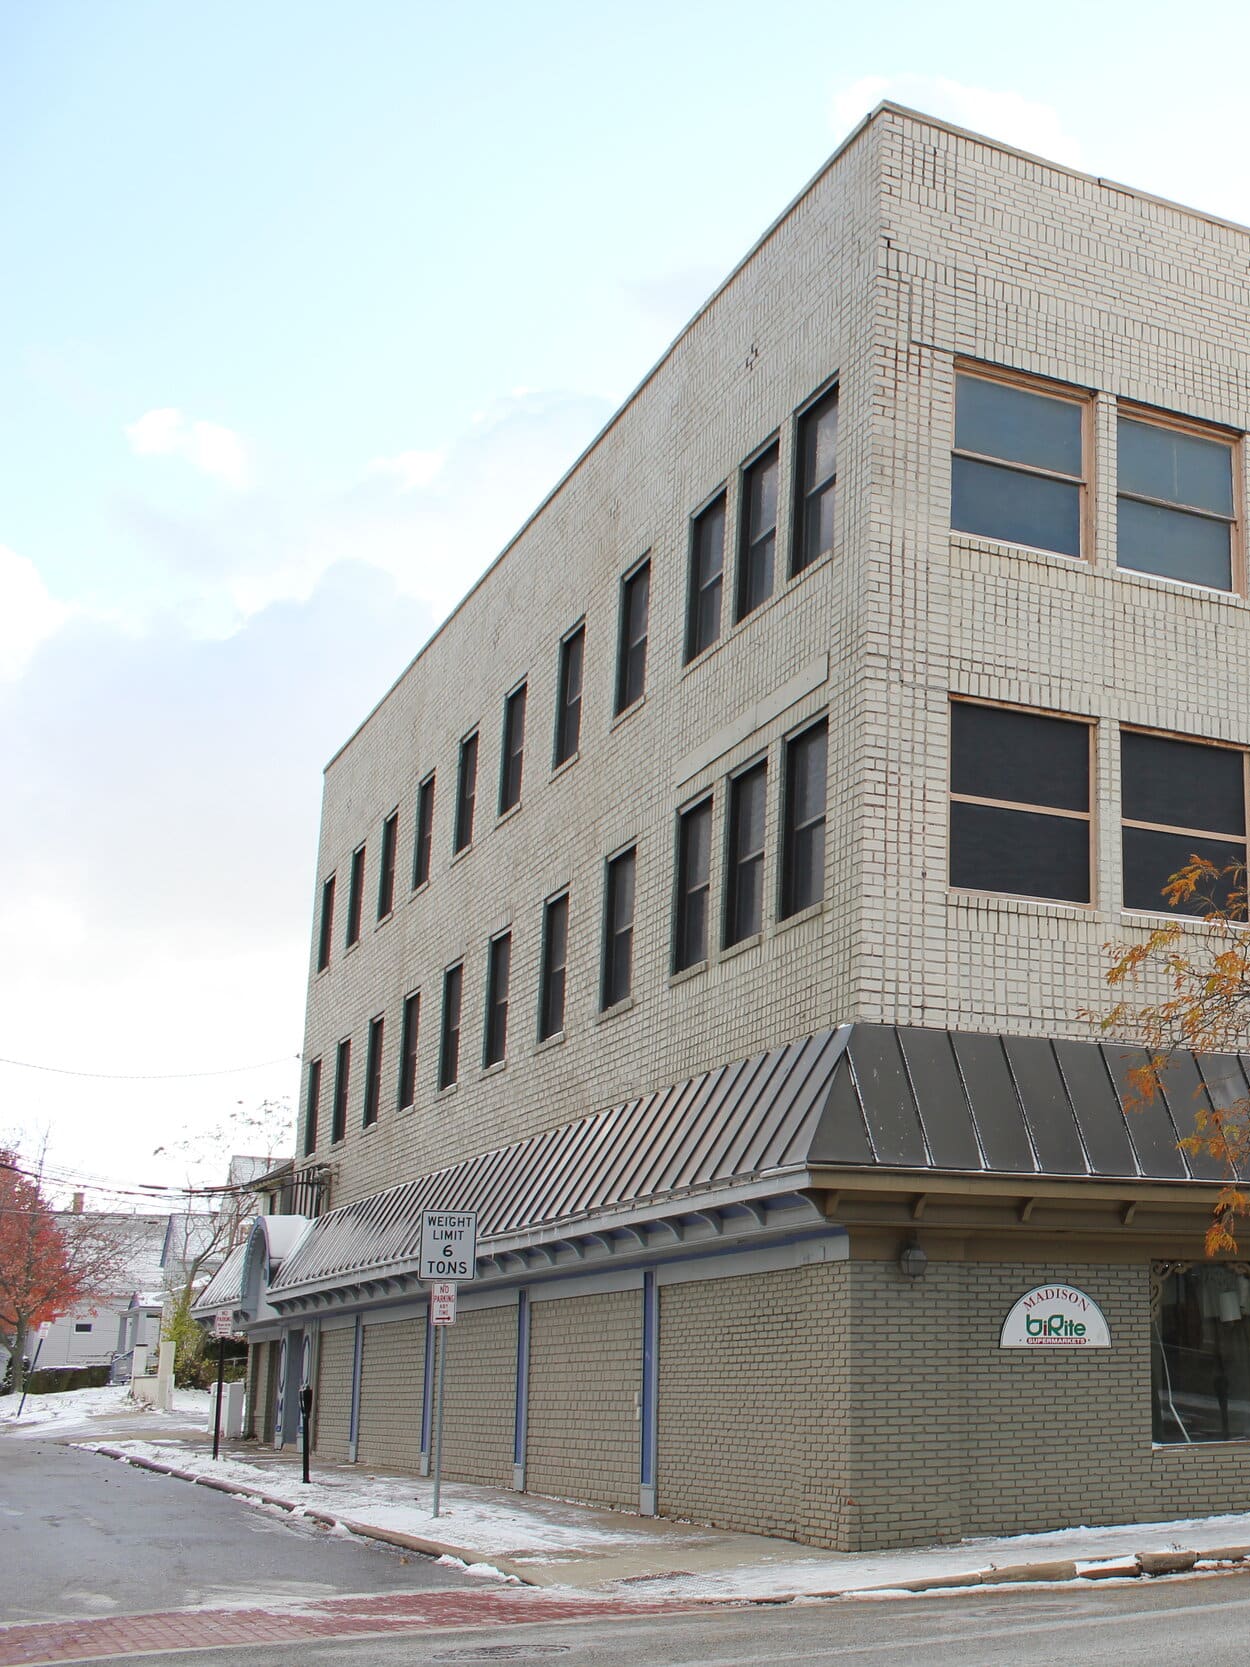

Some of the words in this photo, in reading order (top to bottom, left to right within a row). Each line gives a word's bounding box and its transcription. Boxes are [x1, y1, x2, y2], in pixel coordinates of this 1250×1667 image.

[428, 1216, 472, 1227] WEIGHT
[433, 1230, 464, 1240] LIMIT
[443, 1245, 453, 1257] 6
[428, 1261, 467, 1274] TONS
[1023, 1288, 1090, 1312] MADISON
[1026, 1314, 1086, 1336] biRite
